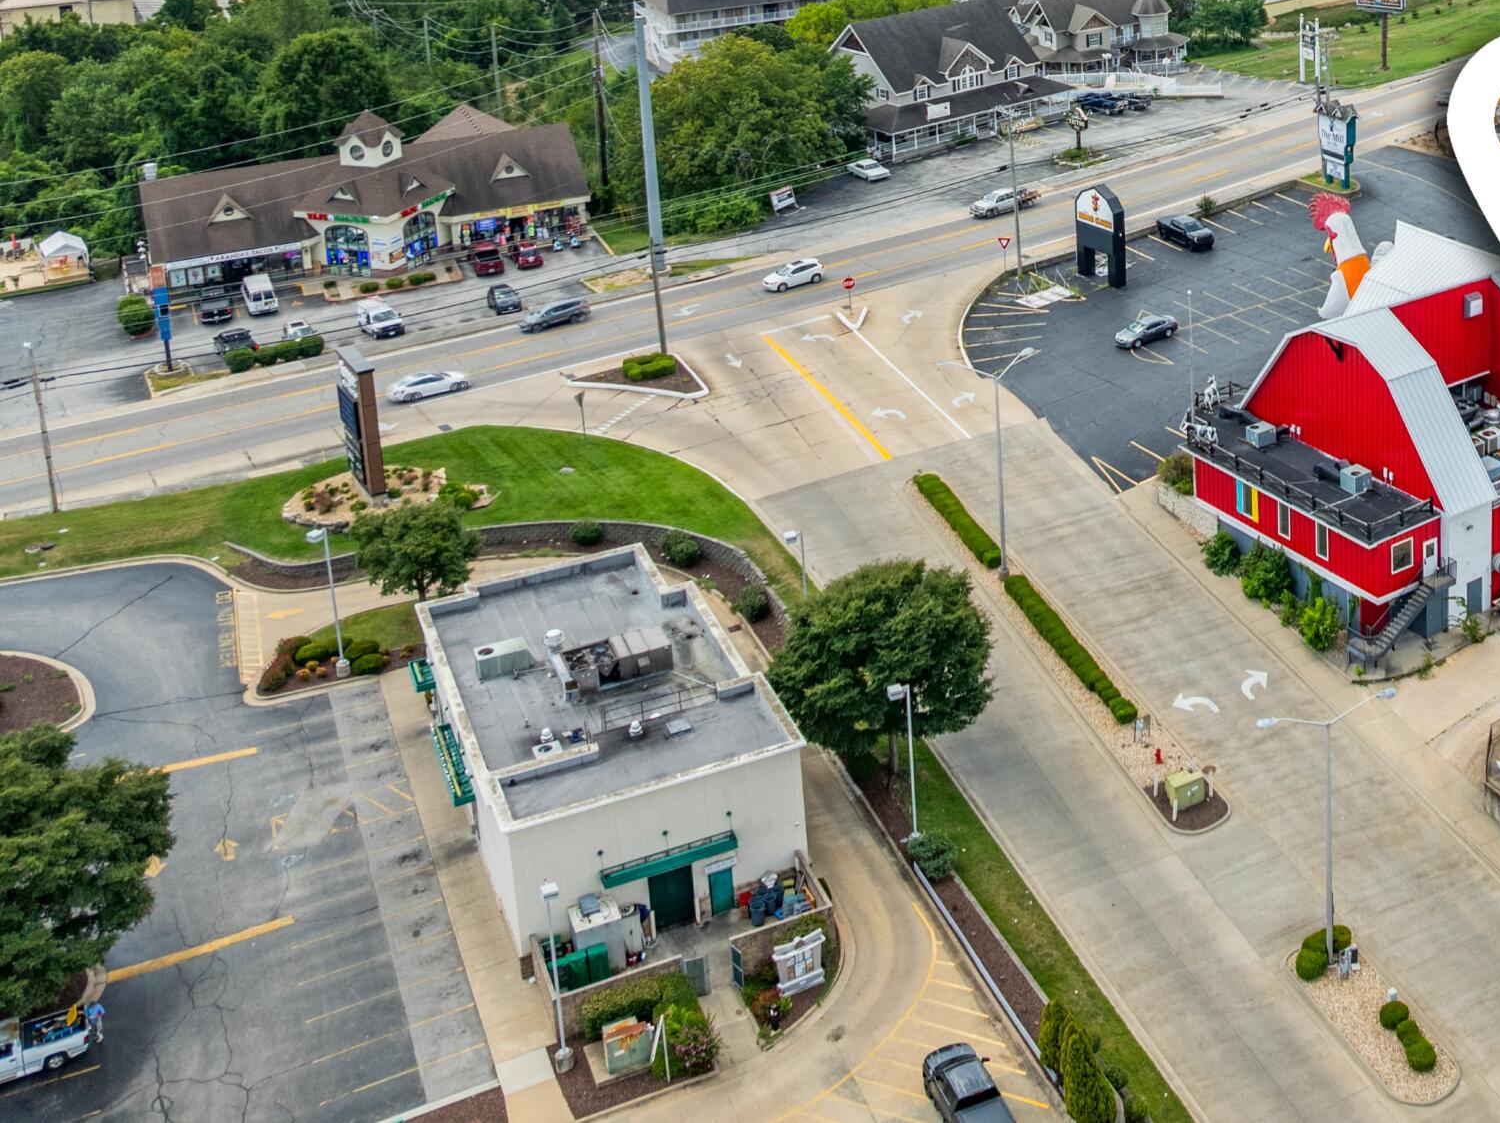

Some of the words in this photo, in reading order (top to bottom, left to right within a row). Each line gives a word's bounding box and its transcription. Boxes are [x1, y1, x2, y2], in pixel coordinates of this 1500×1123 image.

[1321, 129, 1331, 139] The
[1333, 133, 1344, 144] Mill
[216, 590, 232, 605] DO
